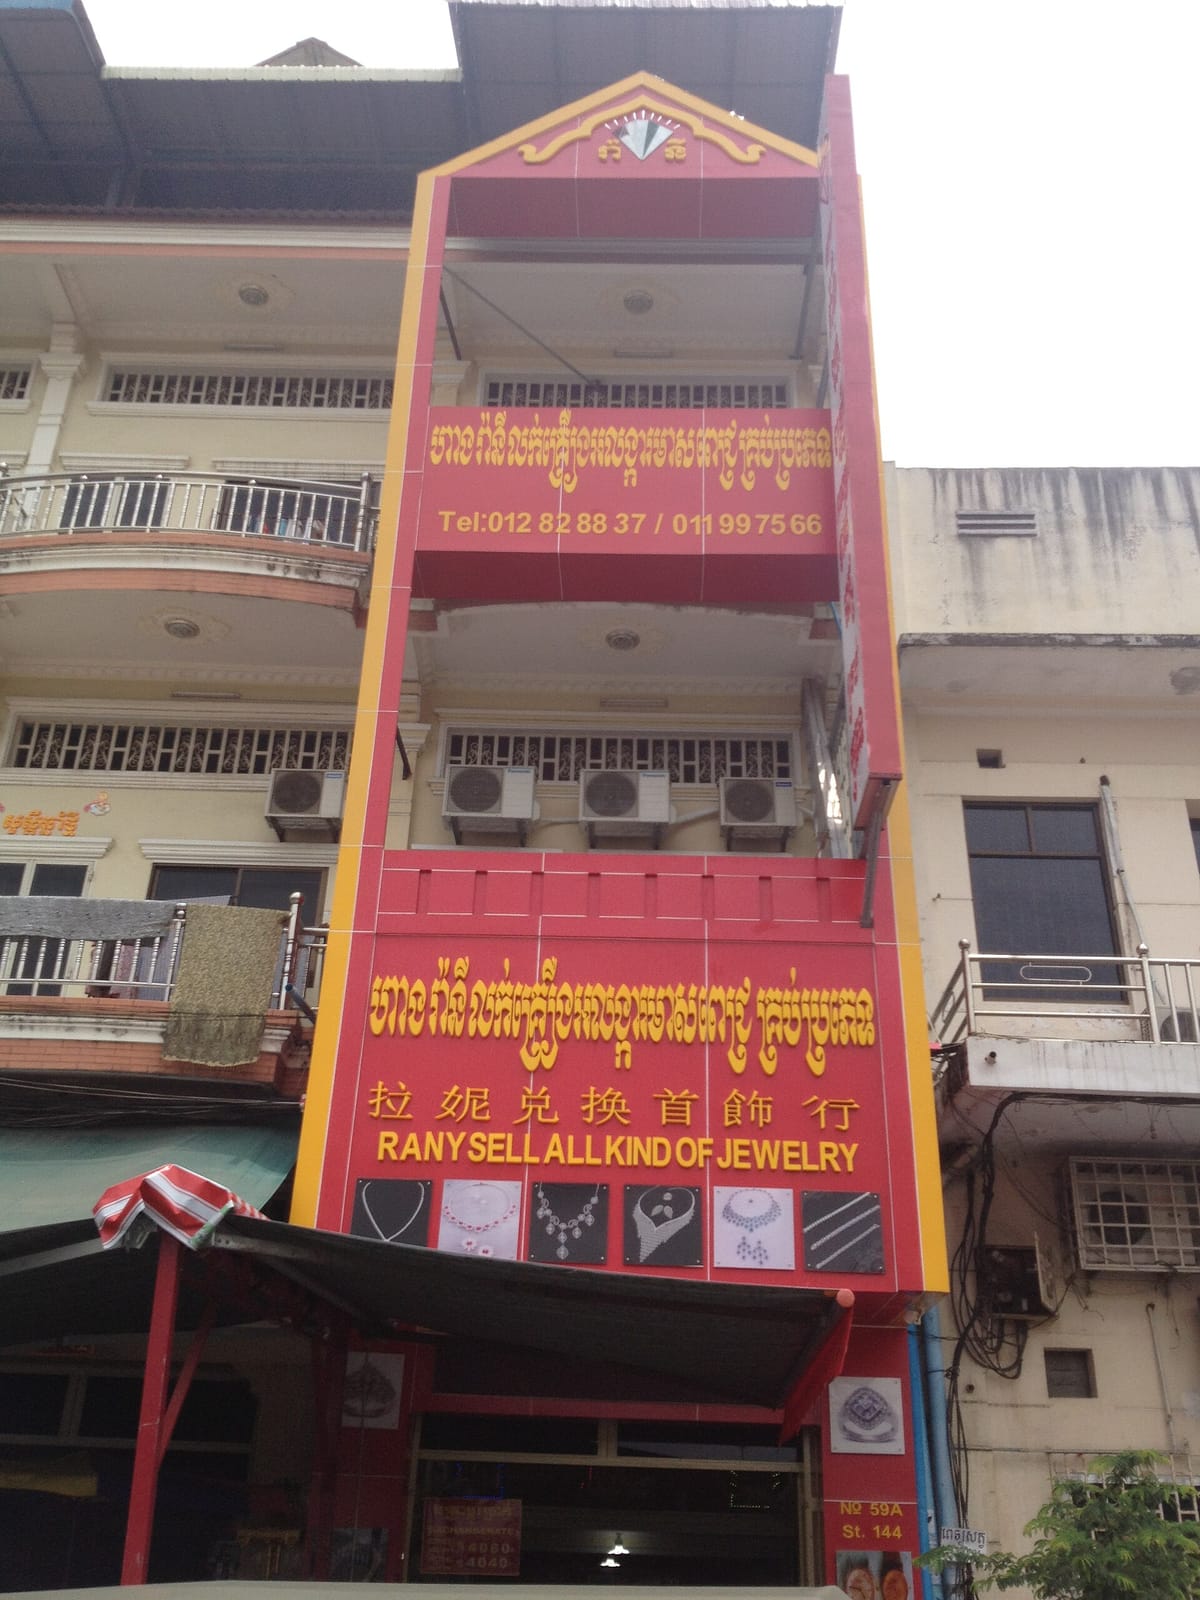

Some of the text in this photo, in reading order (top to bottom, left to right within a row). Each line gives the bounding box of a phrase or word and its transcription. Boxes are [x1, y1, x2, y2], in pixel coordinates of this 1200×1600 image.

[538, 512, 571, 534] 82
[576, 513, 608, 534] 88
[614, 513, 647, 534] 37
[377, 1131, 859, 1173] RANY SELL ALL KIND OF JEWELRY
[870, 1502, 903, 1517] 59A
[873, 1525, 902, 1539] 144
